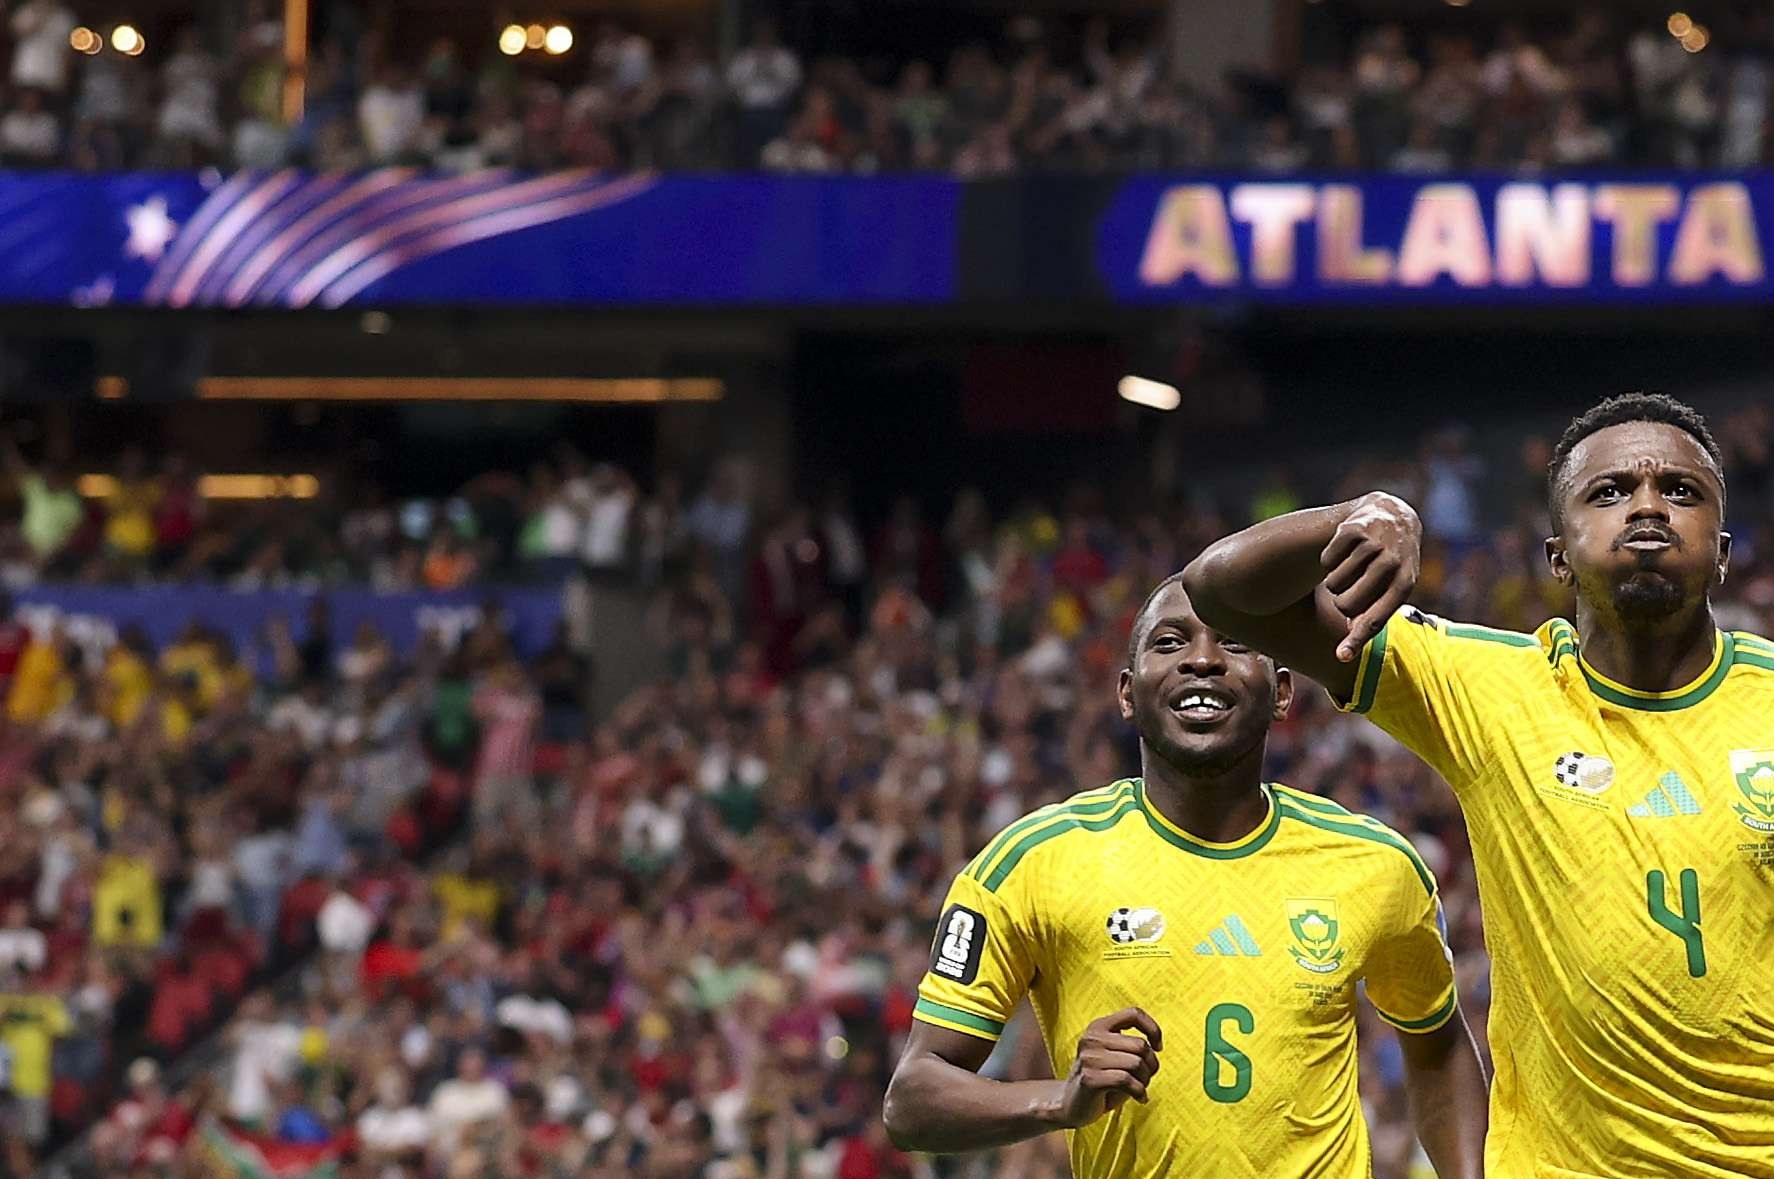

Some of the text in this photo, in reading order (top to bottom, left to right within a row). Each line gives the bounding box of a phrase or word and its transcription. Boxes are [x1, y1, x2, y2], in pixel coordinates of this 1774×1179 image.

[1139, 182, 1765, 288] ATLANTA
[1647, 869, 1706, 977] 4
[1203, 1002, 1254, 1103] 6
